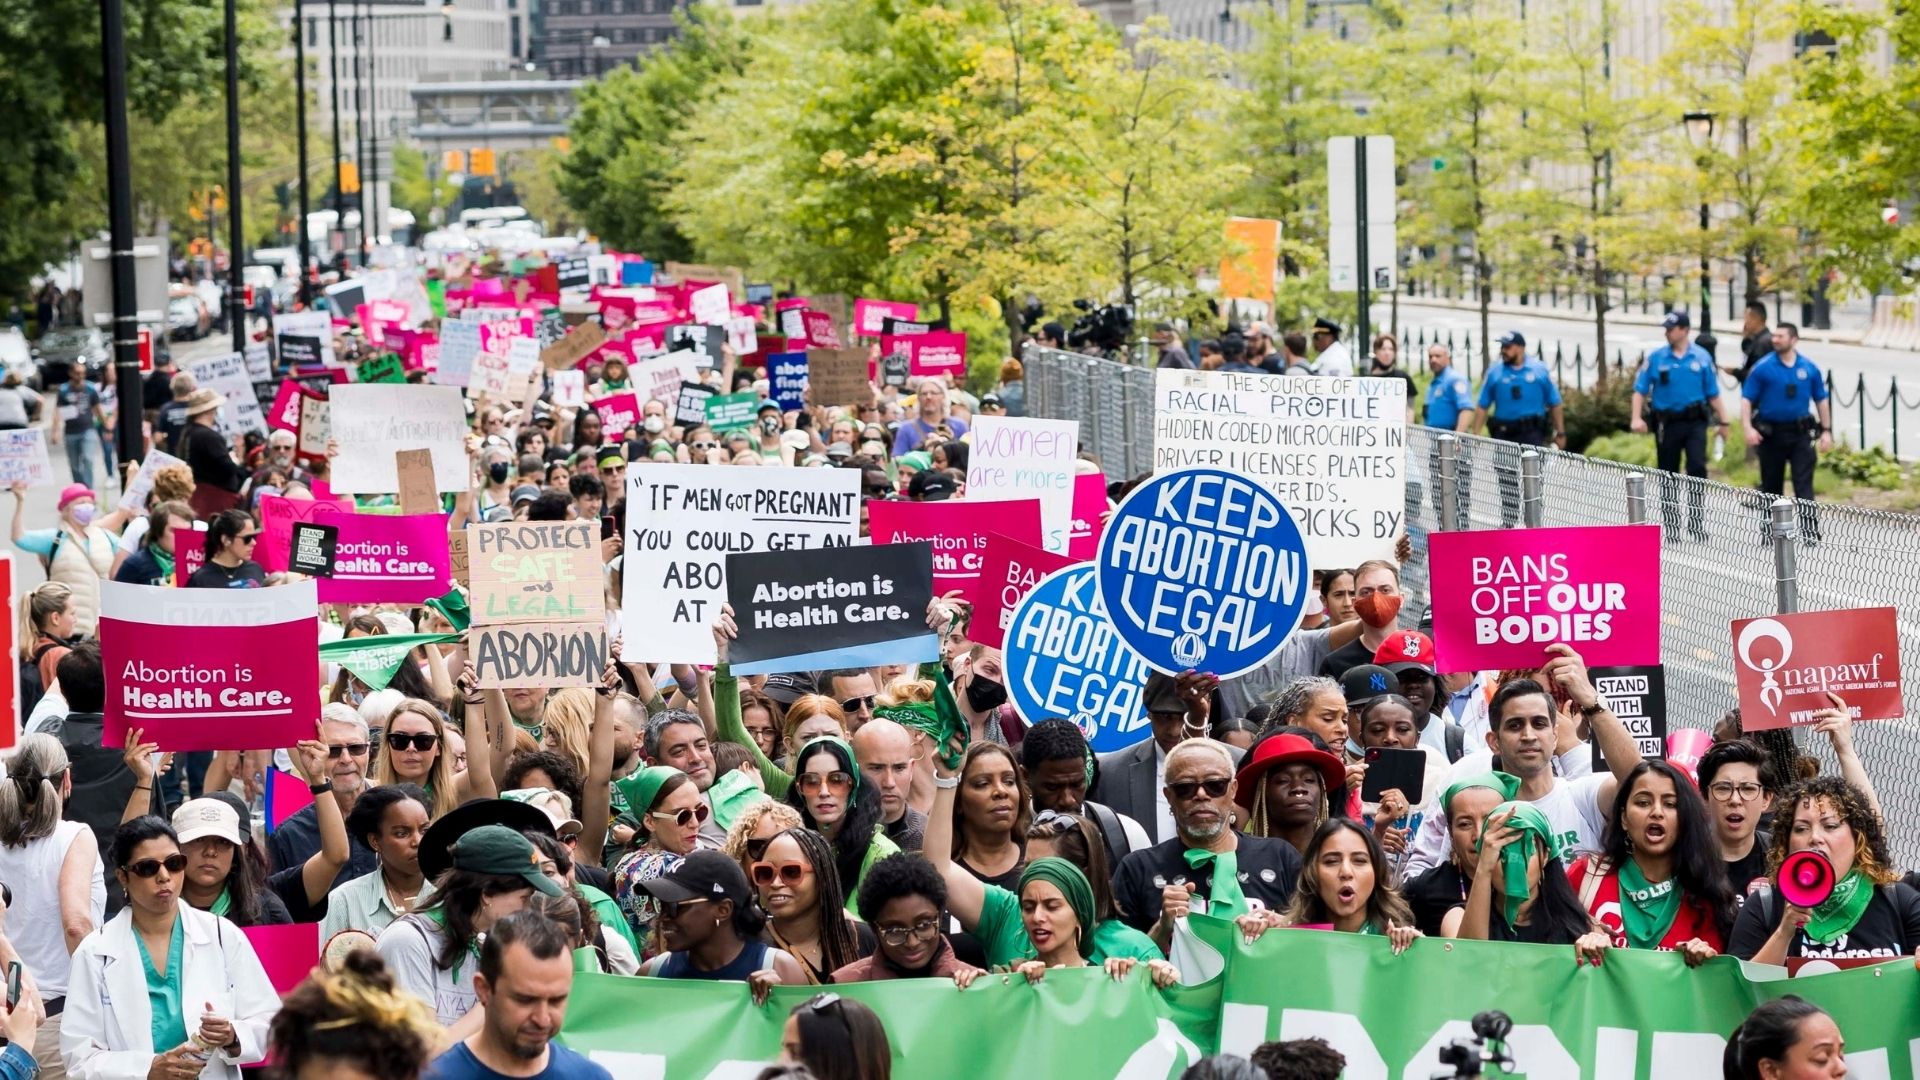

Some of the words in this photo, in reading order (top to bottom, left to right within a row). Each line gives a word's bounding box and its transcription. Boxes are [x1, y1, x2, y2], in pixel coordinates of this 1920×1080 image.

[775, 362, 809, 375] abo
[1222, 374, 1252, 393] THE
[1260, 376, 1322, 396] SOURCE
[1332, 378, 1352, 396] OF
[1359, 379, 1404, 396] NYPD
[1168, 390, 1247, 414] RACIAL
[1271, 395, 1380, 419] PROFILE
[975, 425, 1072, 460] Women
[1157, 418, 1213, 441] HIDDEN
[1219, 421, 1272, 444] CODED
[1277, 424, 1377, 447] MICROCHIPS
[1385, 427, 1402, 448] IN
[969, 464, 1005, 489] are
[1015, 469, 1068, 490] more
[1328, 454, 1396, 478] PLATES
[682, 488, 722, 511] MEN
[725, 493, 752, 513] GOT
[754, 489, 856, 518] PREGNANT
[1153, 475, 1279, 540] KEEP
[1374, 510, 1403, 539] BY
[335, 541, 391, 556] bortion
[396, 541, 409, 556] is
[478, 525, 591, 553] PROTECT
[632, 528, 671, 550] YOU
[686, 530, 754, 552] COULD
[767, 532, 810, 551] GET
[973, 531, 987, 549] is
[334, 557, 382, 574] ealth
[385, 558, 435, 574] Care.
[490, 552, 576, 584] SAFE
[1110, 515, 1300, 606] ABORTION
[1471, 553, 1569, 585] BANS
[663, 561, 723, 590] ABO
[752, 577, 866, 604] Abortion
[872, 574, 893, 595] is
[486, 592, 587, 617] LEGAL
[672, 599, 707, 623] AT
[1471, 584, 1542, 615] OFF
[1547, 582, 1626, 612] OUR
[754, 603, 838, 629] Health
[844, 602, 910, 625] Care.
[1120, 574, 1272, 652] LEGAL
[1475, 612, 1612, 646] BODIES
[476, 630, 607, 683] ABORION
[122, 660, 227, 685] Abortion
[235, 663, 253, 683] is
[1598, 678, 1647, 694] STAND
[1783, 653, 1883, 692] napawf
[123, 685, 213, 709] Health
[219, 686, 292, 708] Care.
[1650, 879, 1674, 898] LIB
